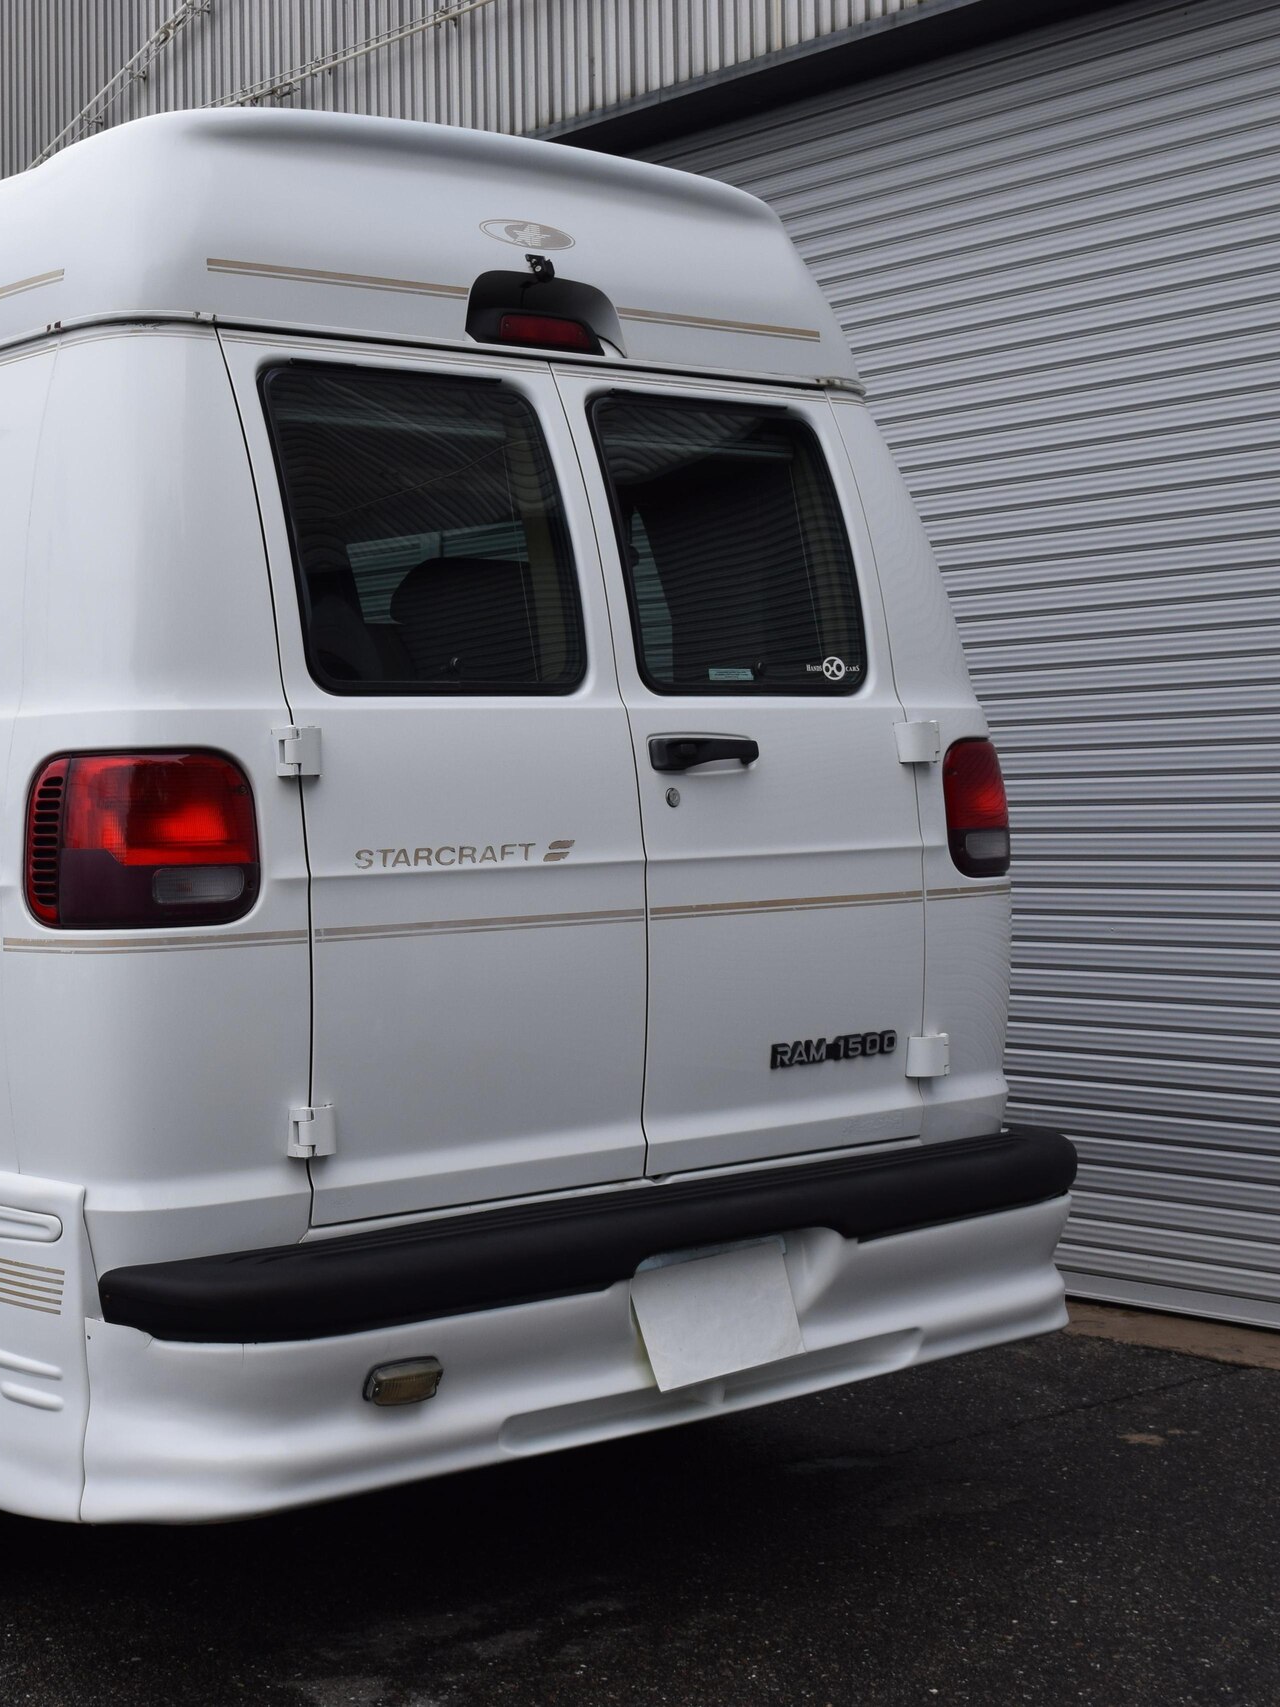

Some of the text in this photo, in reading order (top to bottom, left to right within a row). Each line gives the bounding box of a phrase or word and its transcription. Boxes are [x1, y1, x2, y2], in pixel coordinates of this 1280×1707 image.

[355, 843, 536, 869] STARCRAFT
[770, 1030, 897, 1069] RAM 1500
